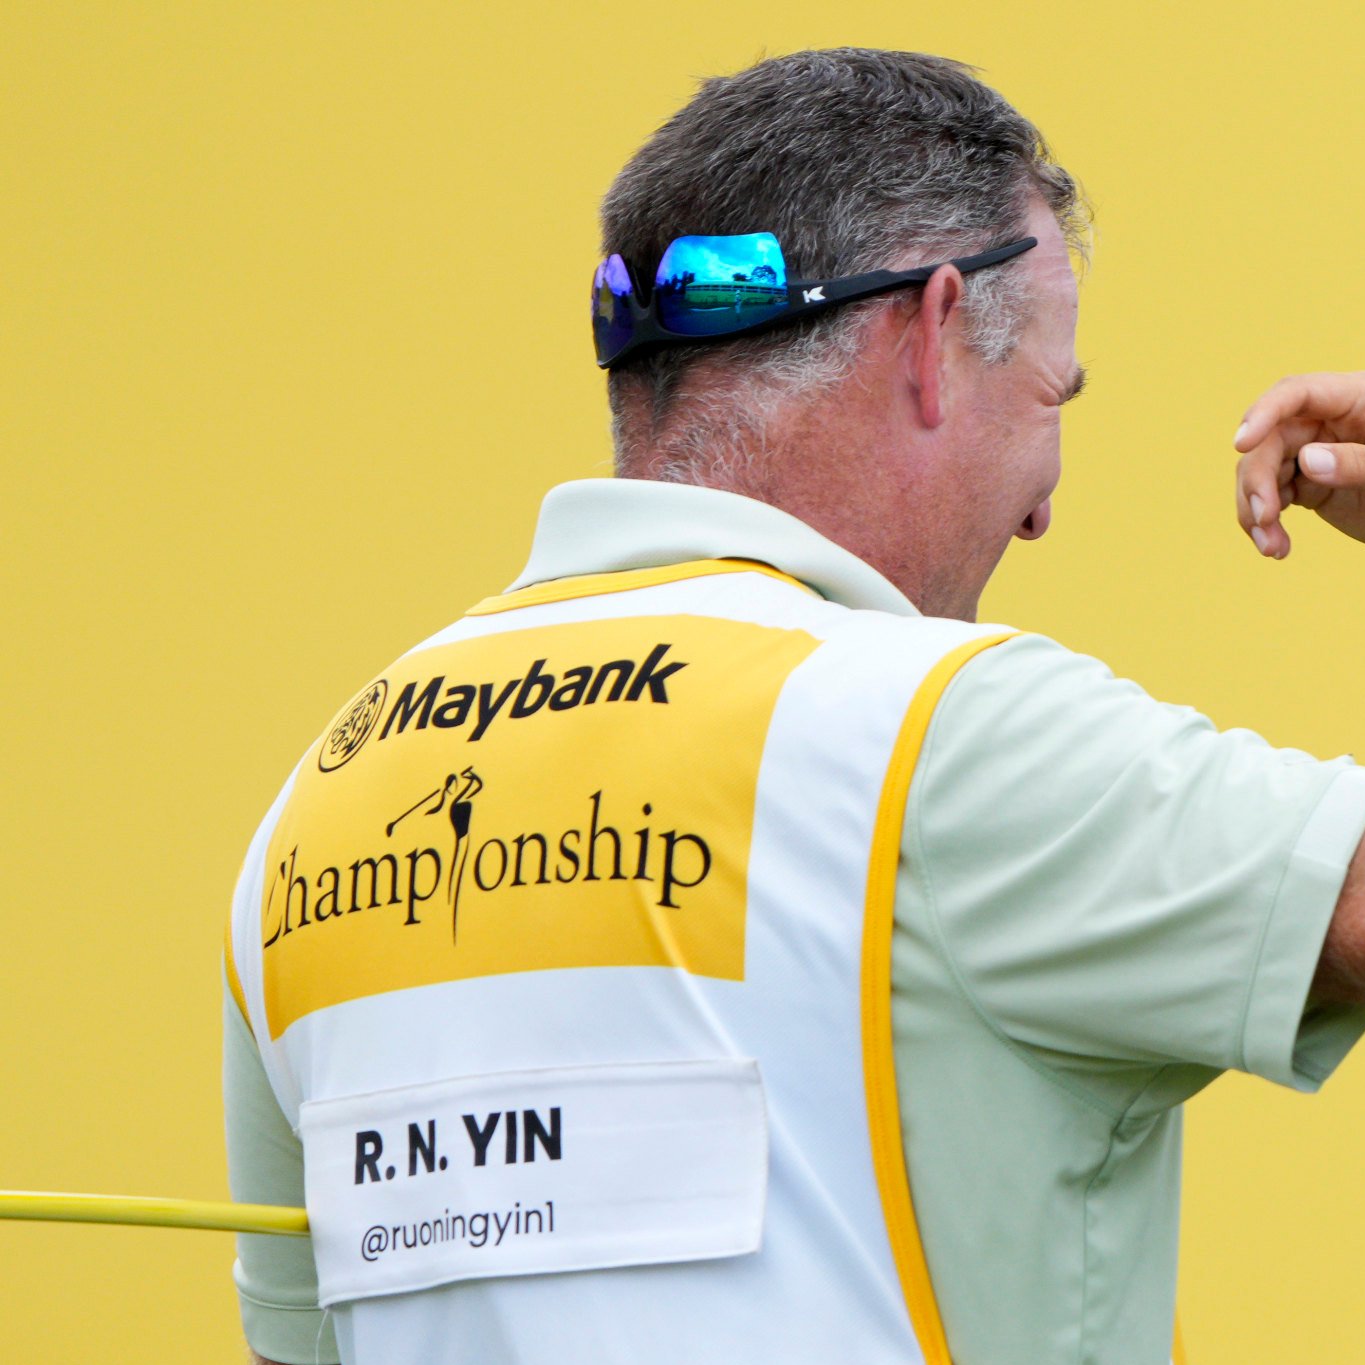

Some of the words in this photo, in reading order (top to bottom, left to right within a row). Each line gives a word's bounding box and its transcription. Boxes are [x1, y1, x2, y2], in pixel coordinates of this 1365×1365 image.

[378, 643, 689, 742] Maybank
[354, 1129, 396, 1186] R.
[407, 1118, 448, 1177] N.
[461, 1106, 562, 1167] YIN
[361, 1200, 555, 1262] @ruoningyin1
